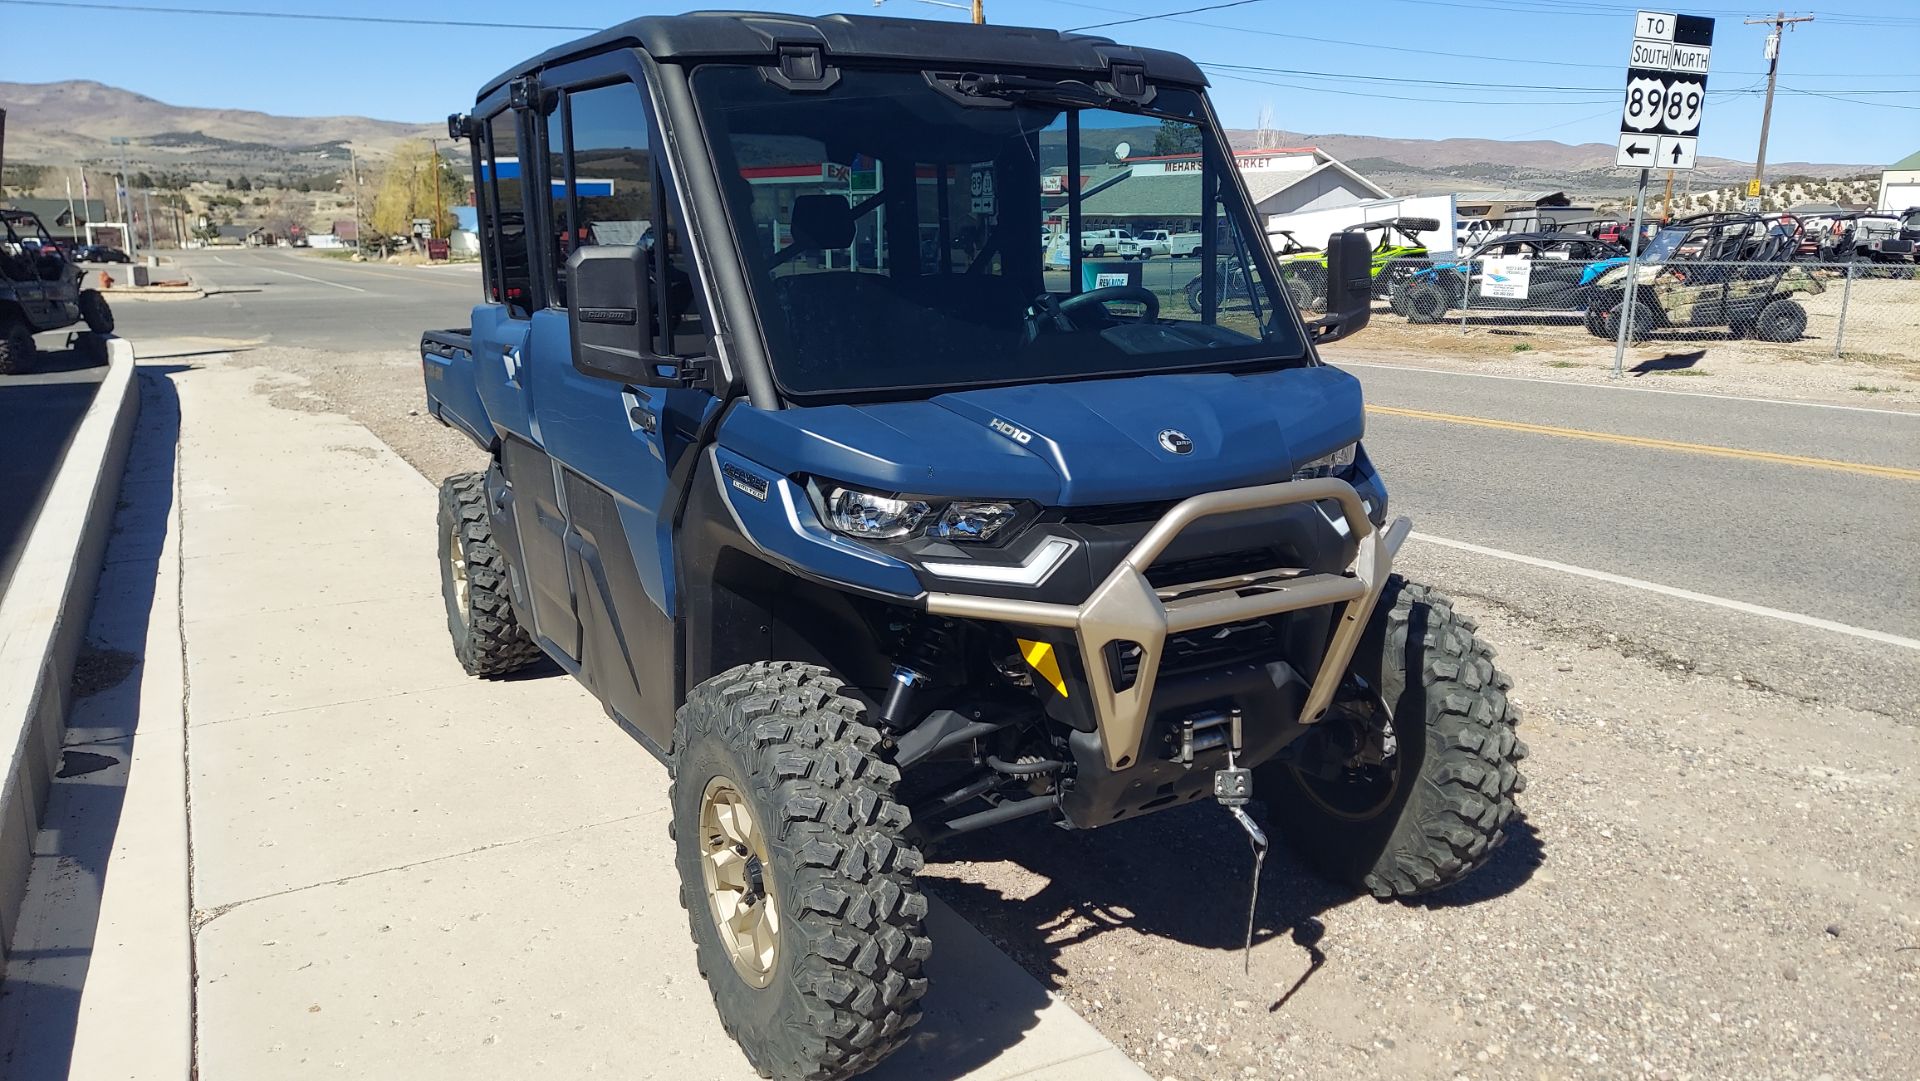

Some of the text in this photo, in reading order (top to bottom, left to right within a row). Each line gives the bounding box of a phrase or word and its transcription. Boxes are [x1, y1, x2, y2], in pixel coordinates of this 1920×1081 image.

[1647, 17, 1665, 34] TO
[1633, 45, 1669, 67] SOUTH
[1673, 48, 1708, 69] NORTH
[1628, 87, 1662, 118] 89
[1667, 90, 1700, 121] 89
[1235, 157, 1272, 169] ARKET
[972, 176, 981, 190] 89
[989, 418, 1032, 444] HD10
